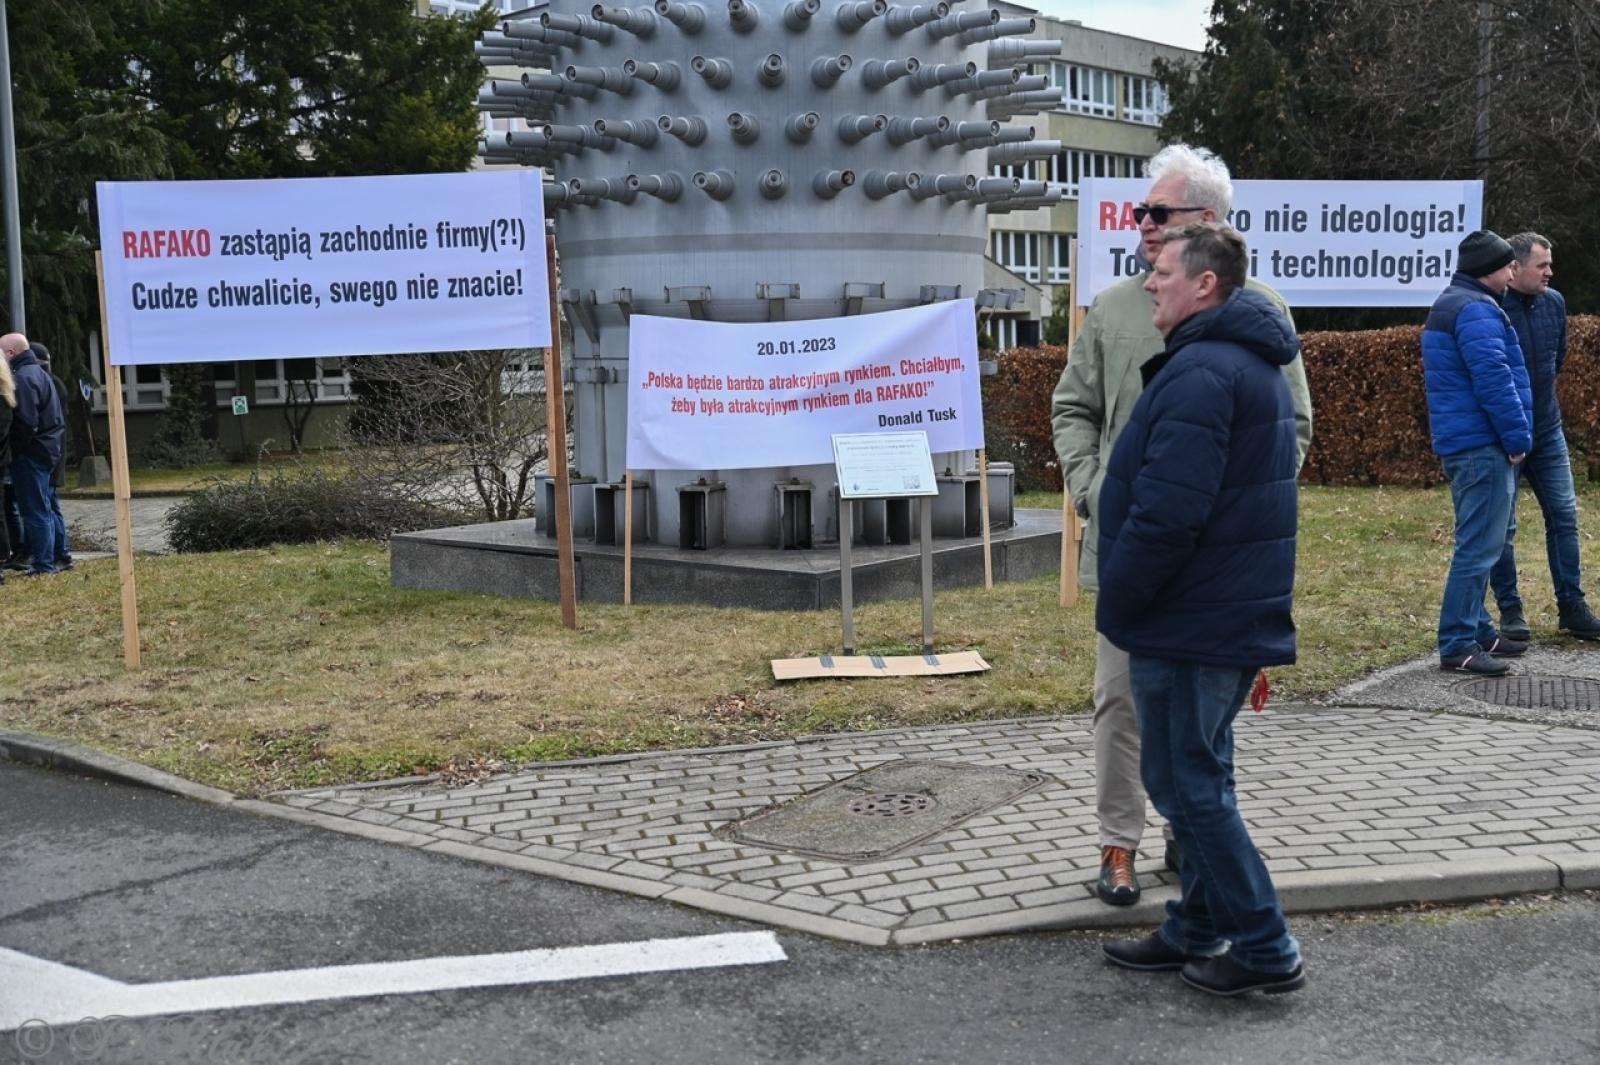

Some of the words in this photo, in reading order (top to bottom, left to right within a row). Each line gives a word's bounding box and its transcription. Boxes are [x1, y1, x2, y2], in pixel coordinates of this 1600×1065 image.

[123, 229, 210, 258] RAFAKO
[220, 227, 312, 260] zastąpią
[320, 223, 427, 253] zachodnie
[436, 218, 525, 253] firmy(?!)
[1265, 204, 1307, 232] nie
[1321, 204, 1465, 239] ideologia!
[1109, 248, 1140, 277] To
[1271, 249, 1452, 284] technologia!
[132, 282, 198, 310] Cudze
[208, 278, 320, 309] chwalicie,
[330, 280, 397, 307] swego
[407, 273, 439, 299] nie
[448, 269, 523, 298] znacie!
[757, 337, 835, 355] 20.01.2023
[687, 374, 722, 393] będzie
[726, 375, 764, 391] bardzo
[768, 372, 840, 391] atrakcyjnym
[845, 364, 896, 384] rynkiem.
[900, 357, 965, 378] Chciałbym,
[672, 397, 695, 416] żeby
[700, 398, 724, 416] była
[728, 398, 799, 417] atrakcyjnym
[802, 392, 849, 413] rynkiem
[855, 389, 872, 404] dla
[878, 410, 923, 427] Donald
[928, 407, 957, 422] Tusk
